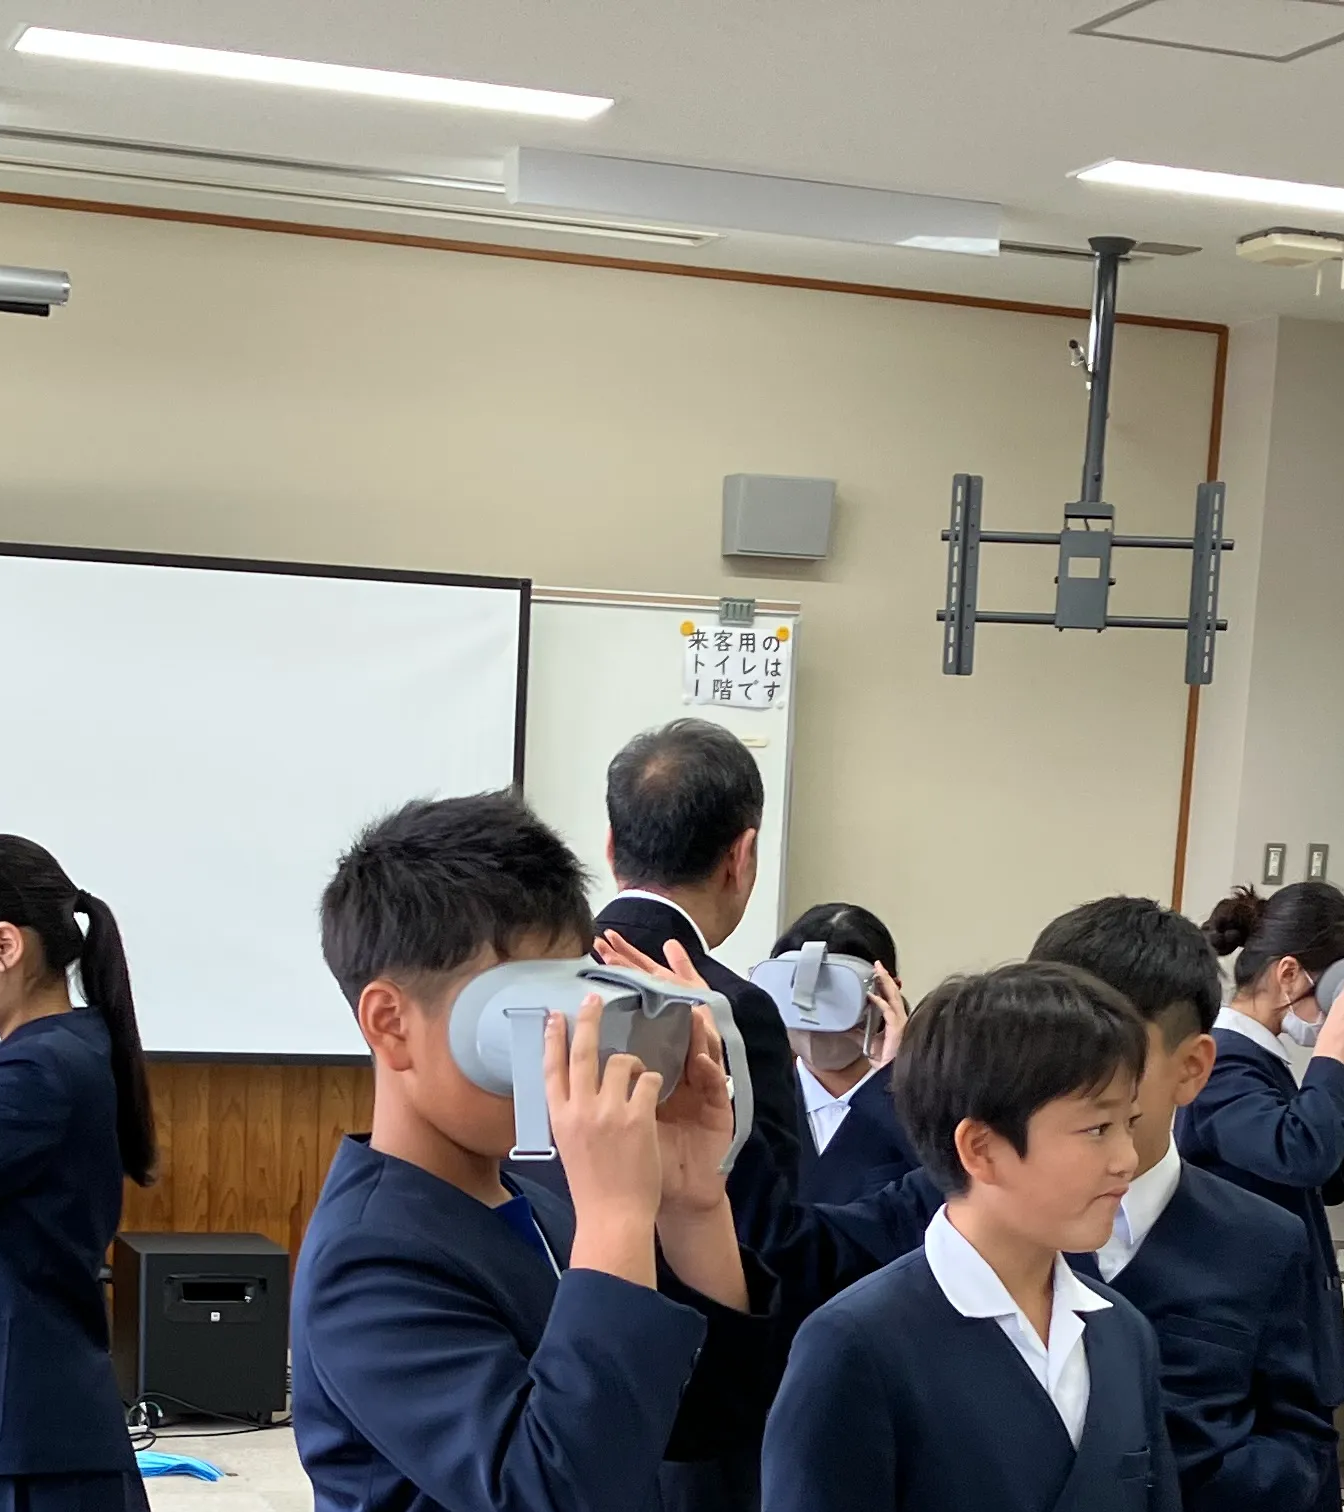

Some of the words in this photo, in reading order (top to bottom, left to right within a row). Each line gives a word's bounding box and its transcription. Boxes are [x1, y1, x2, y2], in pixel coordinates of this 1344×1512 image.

[687, 628, 780, 654] 来客用の
[693, 653, 783, 677] トイレは
